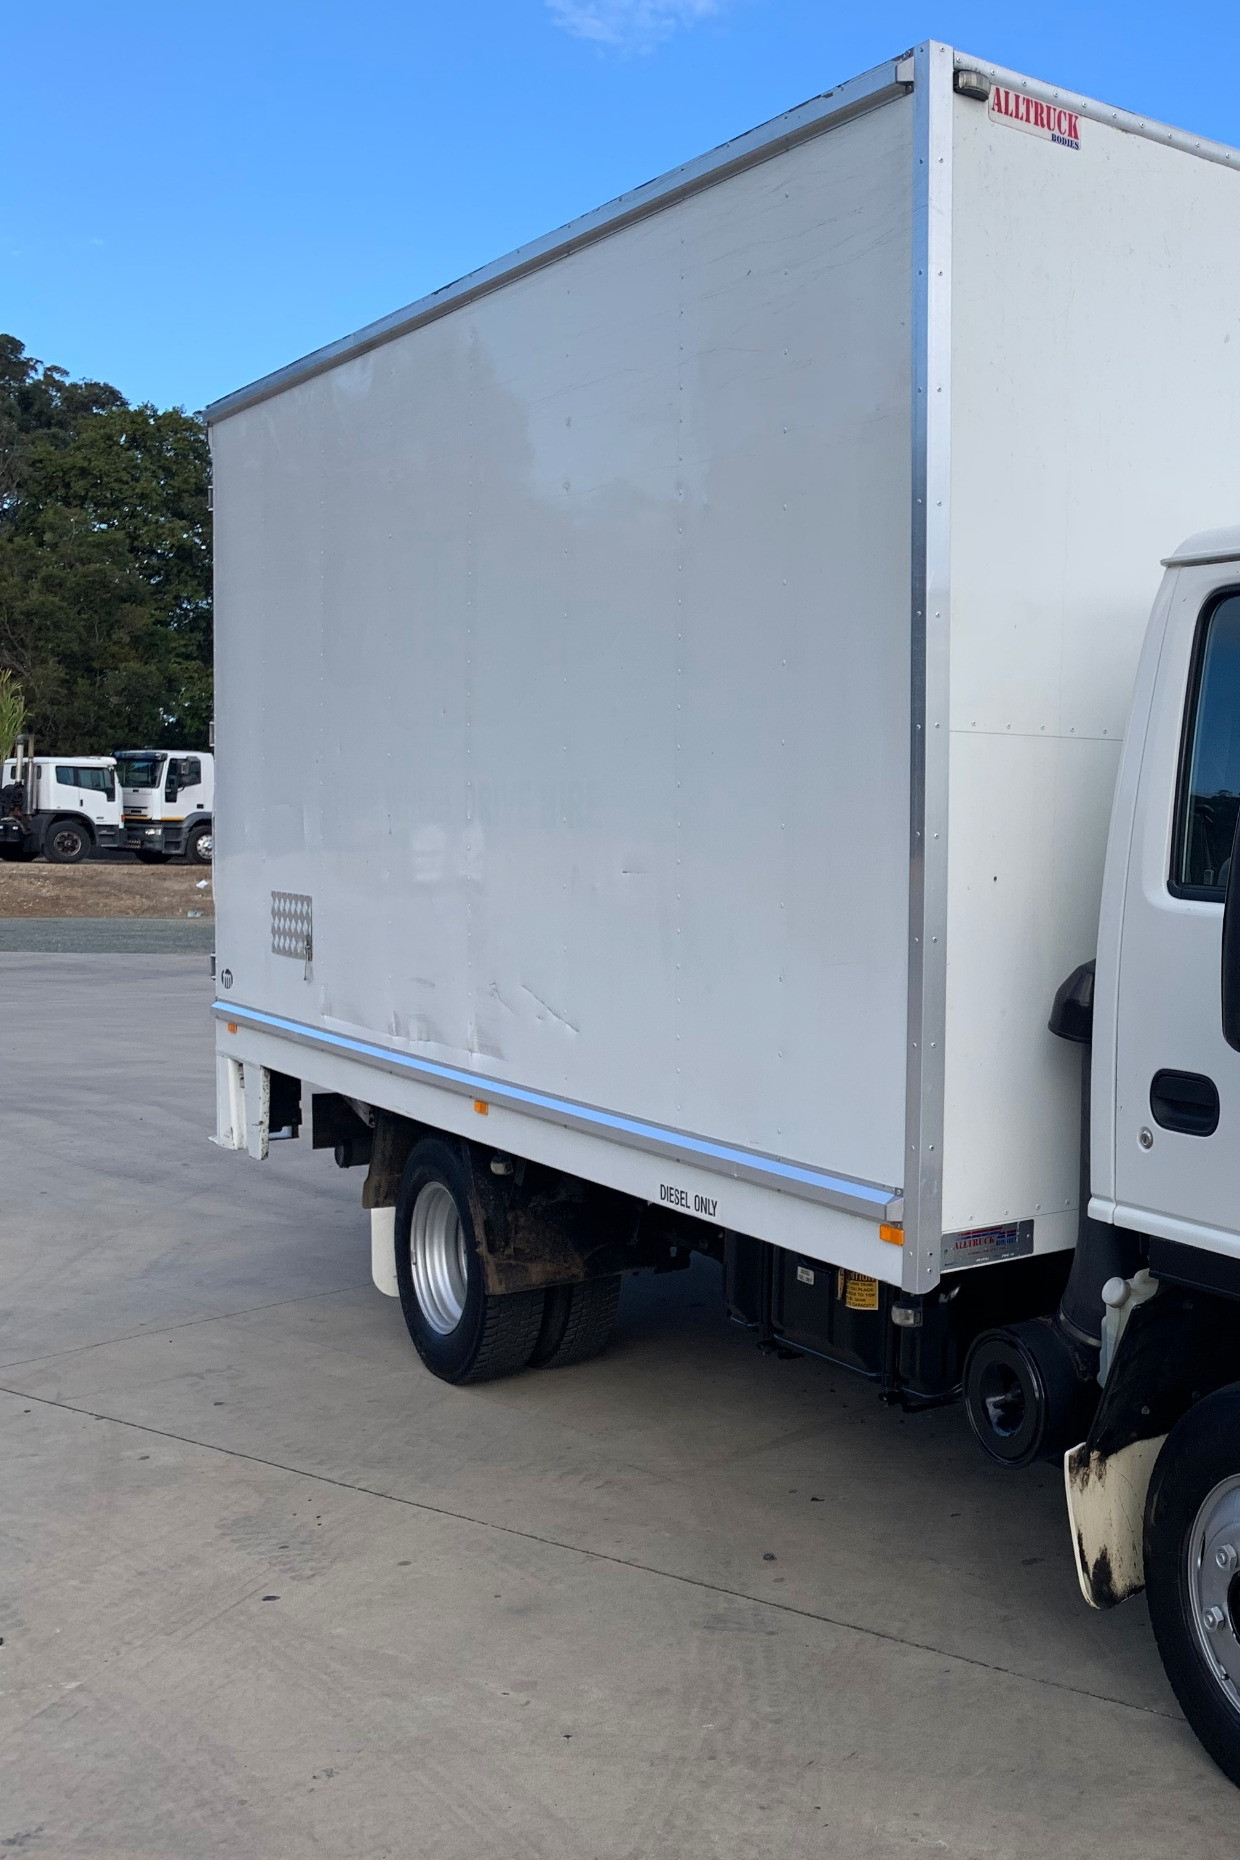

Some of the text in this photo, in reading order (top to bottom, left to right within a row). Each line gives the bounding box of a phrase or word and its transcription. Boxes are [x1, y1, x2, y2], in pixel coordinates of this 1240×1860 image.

[991, 87, 1080, 140] ALLTRUCK
[1051, 133, 1080, 150] BODIES
[660, 1183, 718, 1217] DIESEL ONLY
